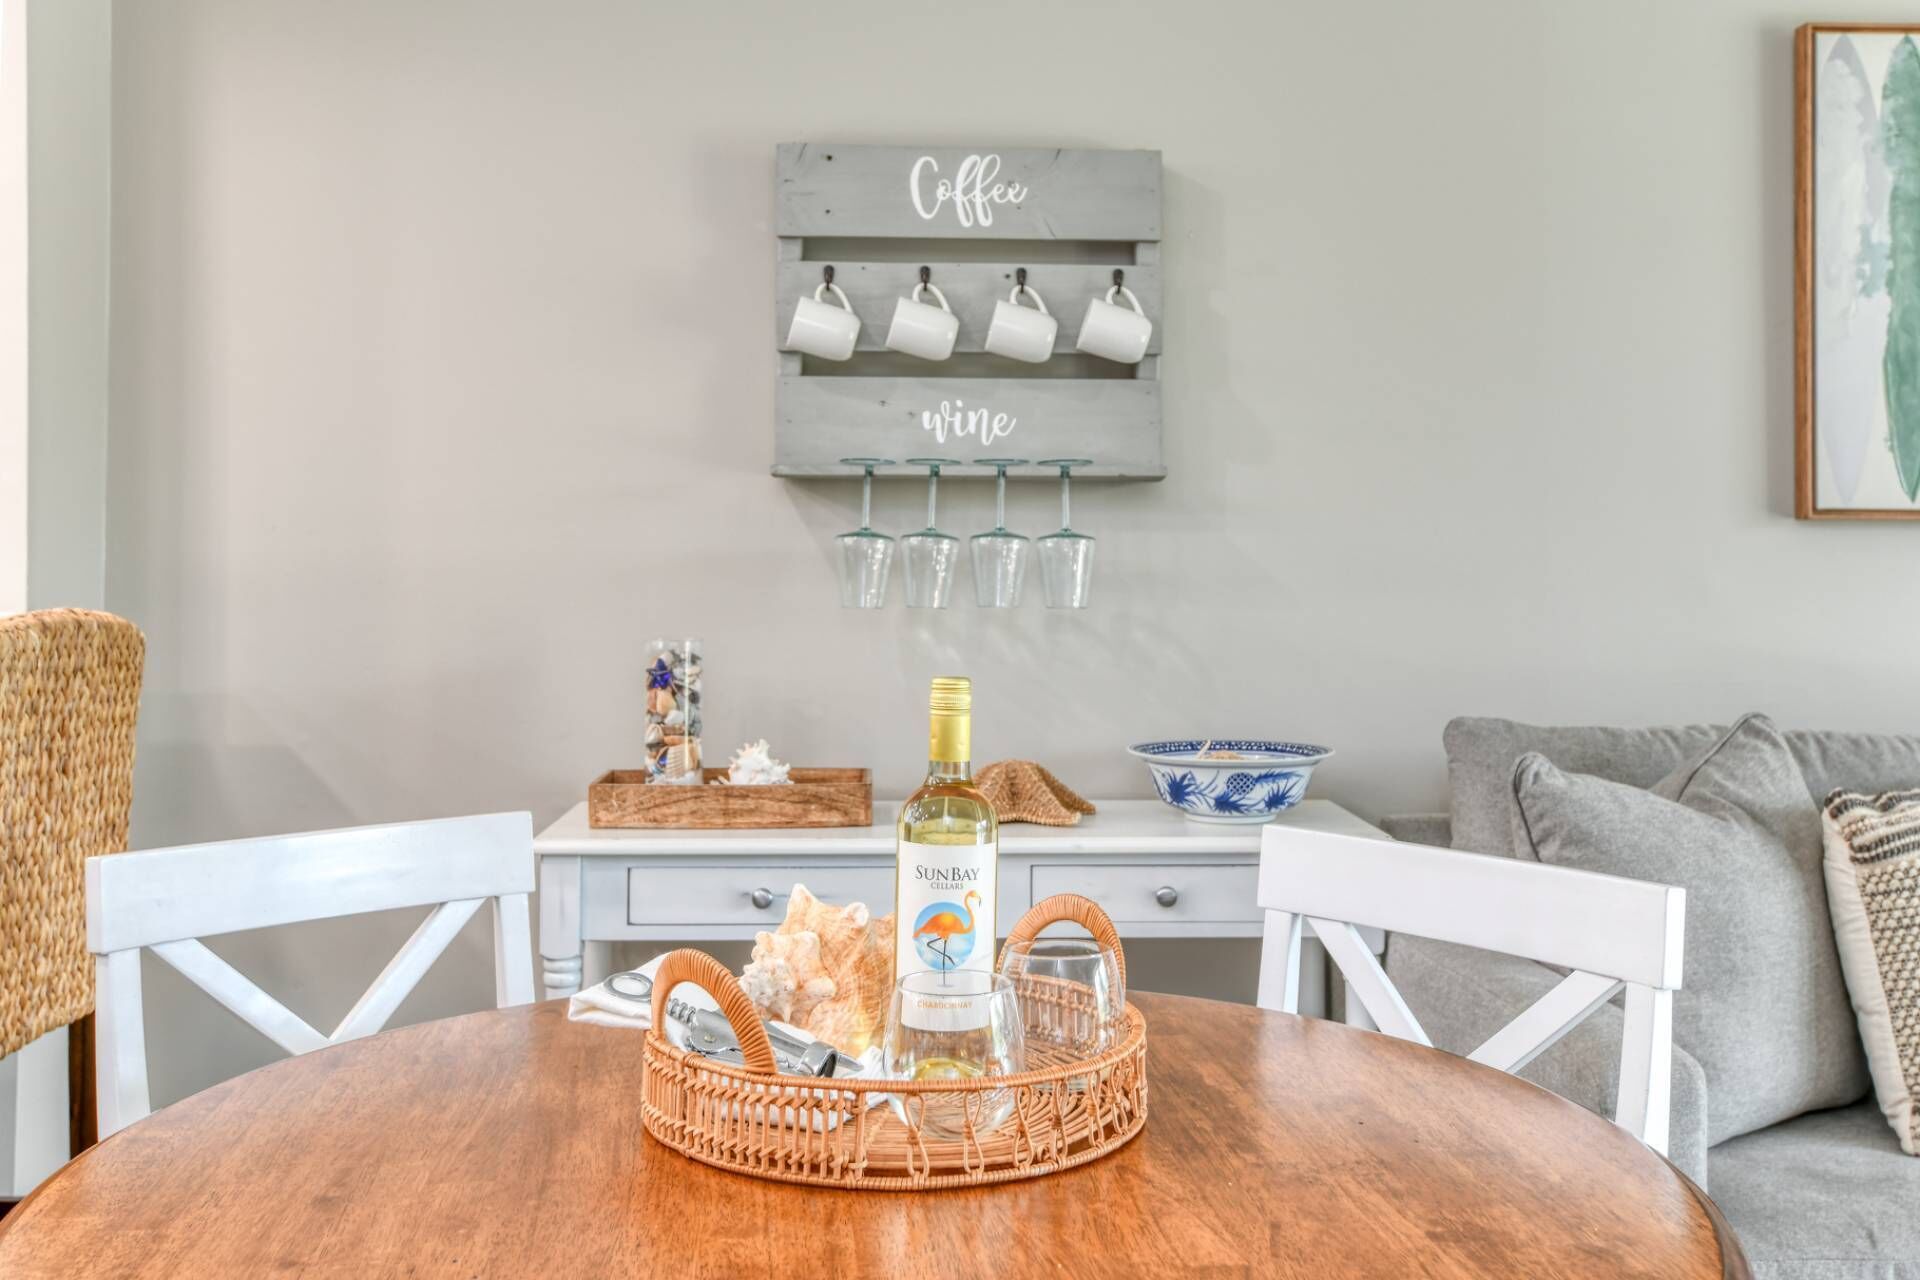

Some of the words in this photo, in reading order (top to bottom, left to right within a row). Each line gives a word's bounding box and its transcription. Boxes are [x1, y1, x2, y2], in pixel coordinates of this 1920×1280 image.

[910, 153, 1028, 227] Coffee
[922, 399, 1017, 446] wine
[930, 881, 964, 890] CELLARS
[916, 1000, 973, 1009] CHARDONNAY
